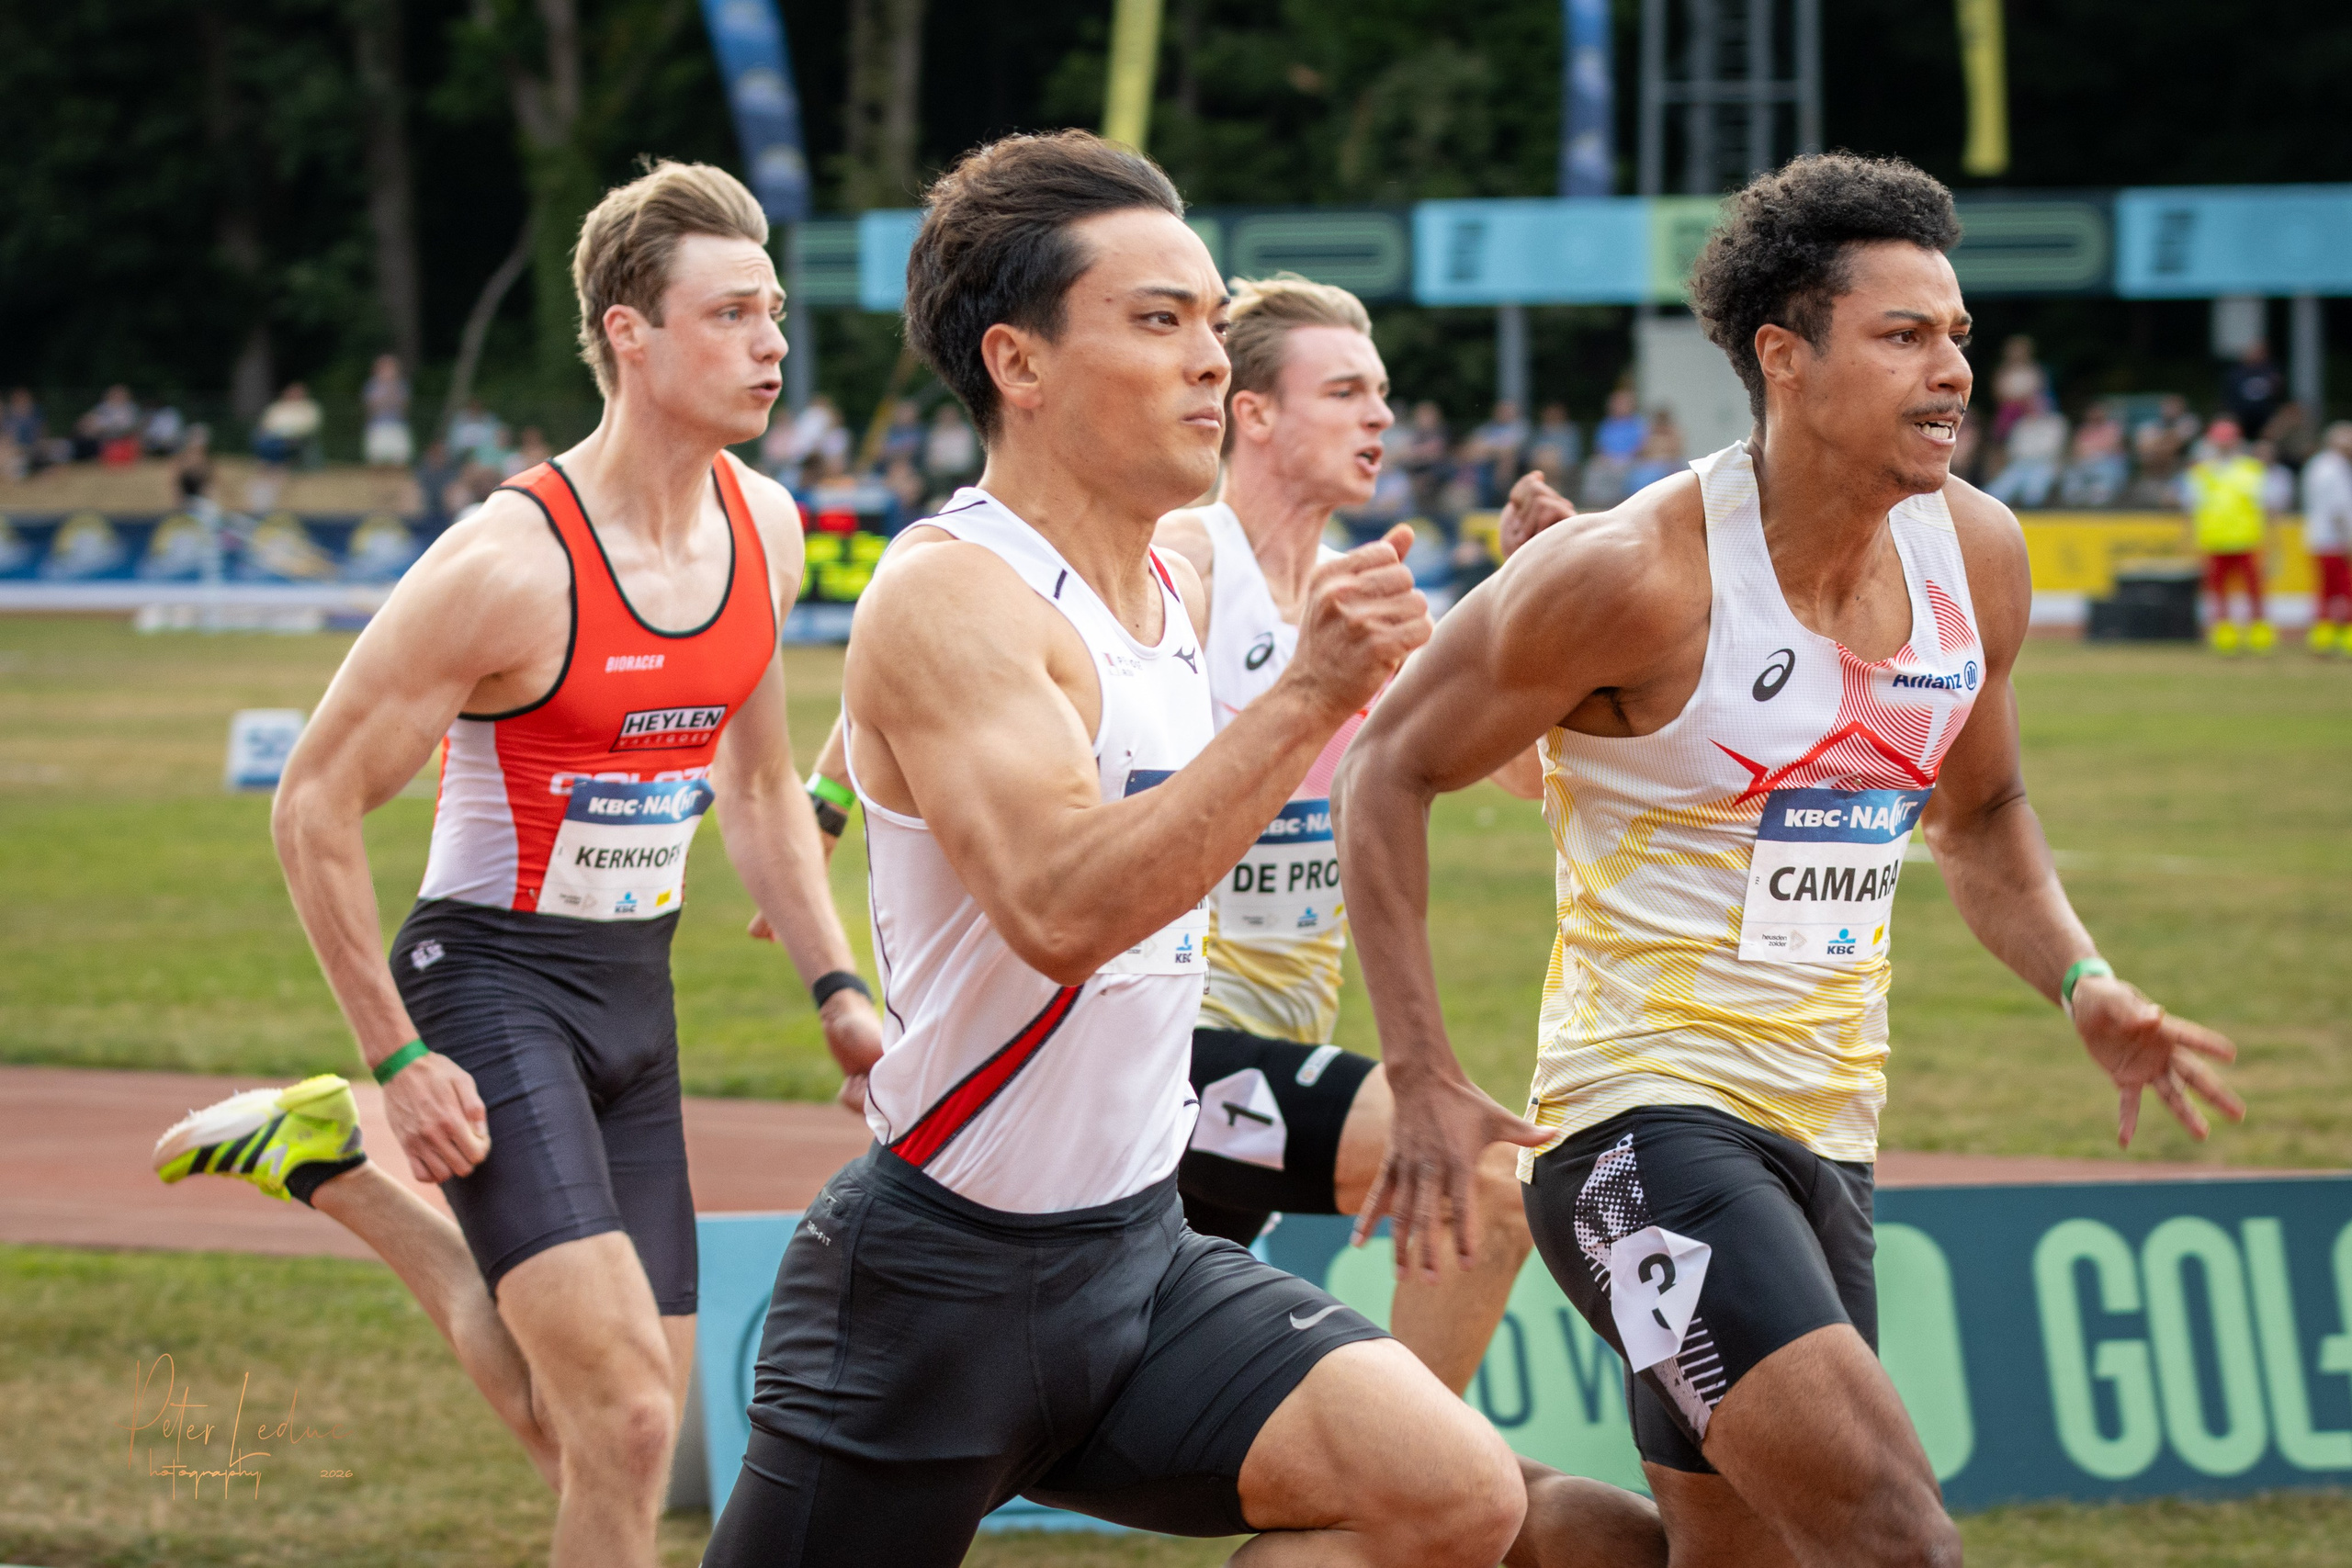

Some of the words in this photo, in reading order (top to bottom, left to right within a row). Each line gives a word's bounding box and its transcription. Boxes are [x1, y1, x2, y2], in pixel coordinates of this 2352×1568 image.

[1893, 673, 1962, 690] Allianz
[625, 709, 722, 734] HEYLEN
[1232, 863, 1277, 893] DE
[1769, 859, 1899, 902] CAMARA
[1827, 945, 1855, 954] KBC
[2031, 1214, 2352, 1481] GOL
